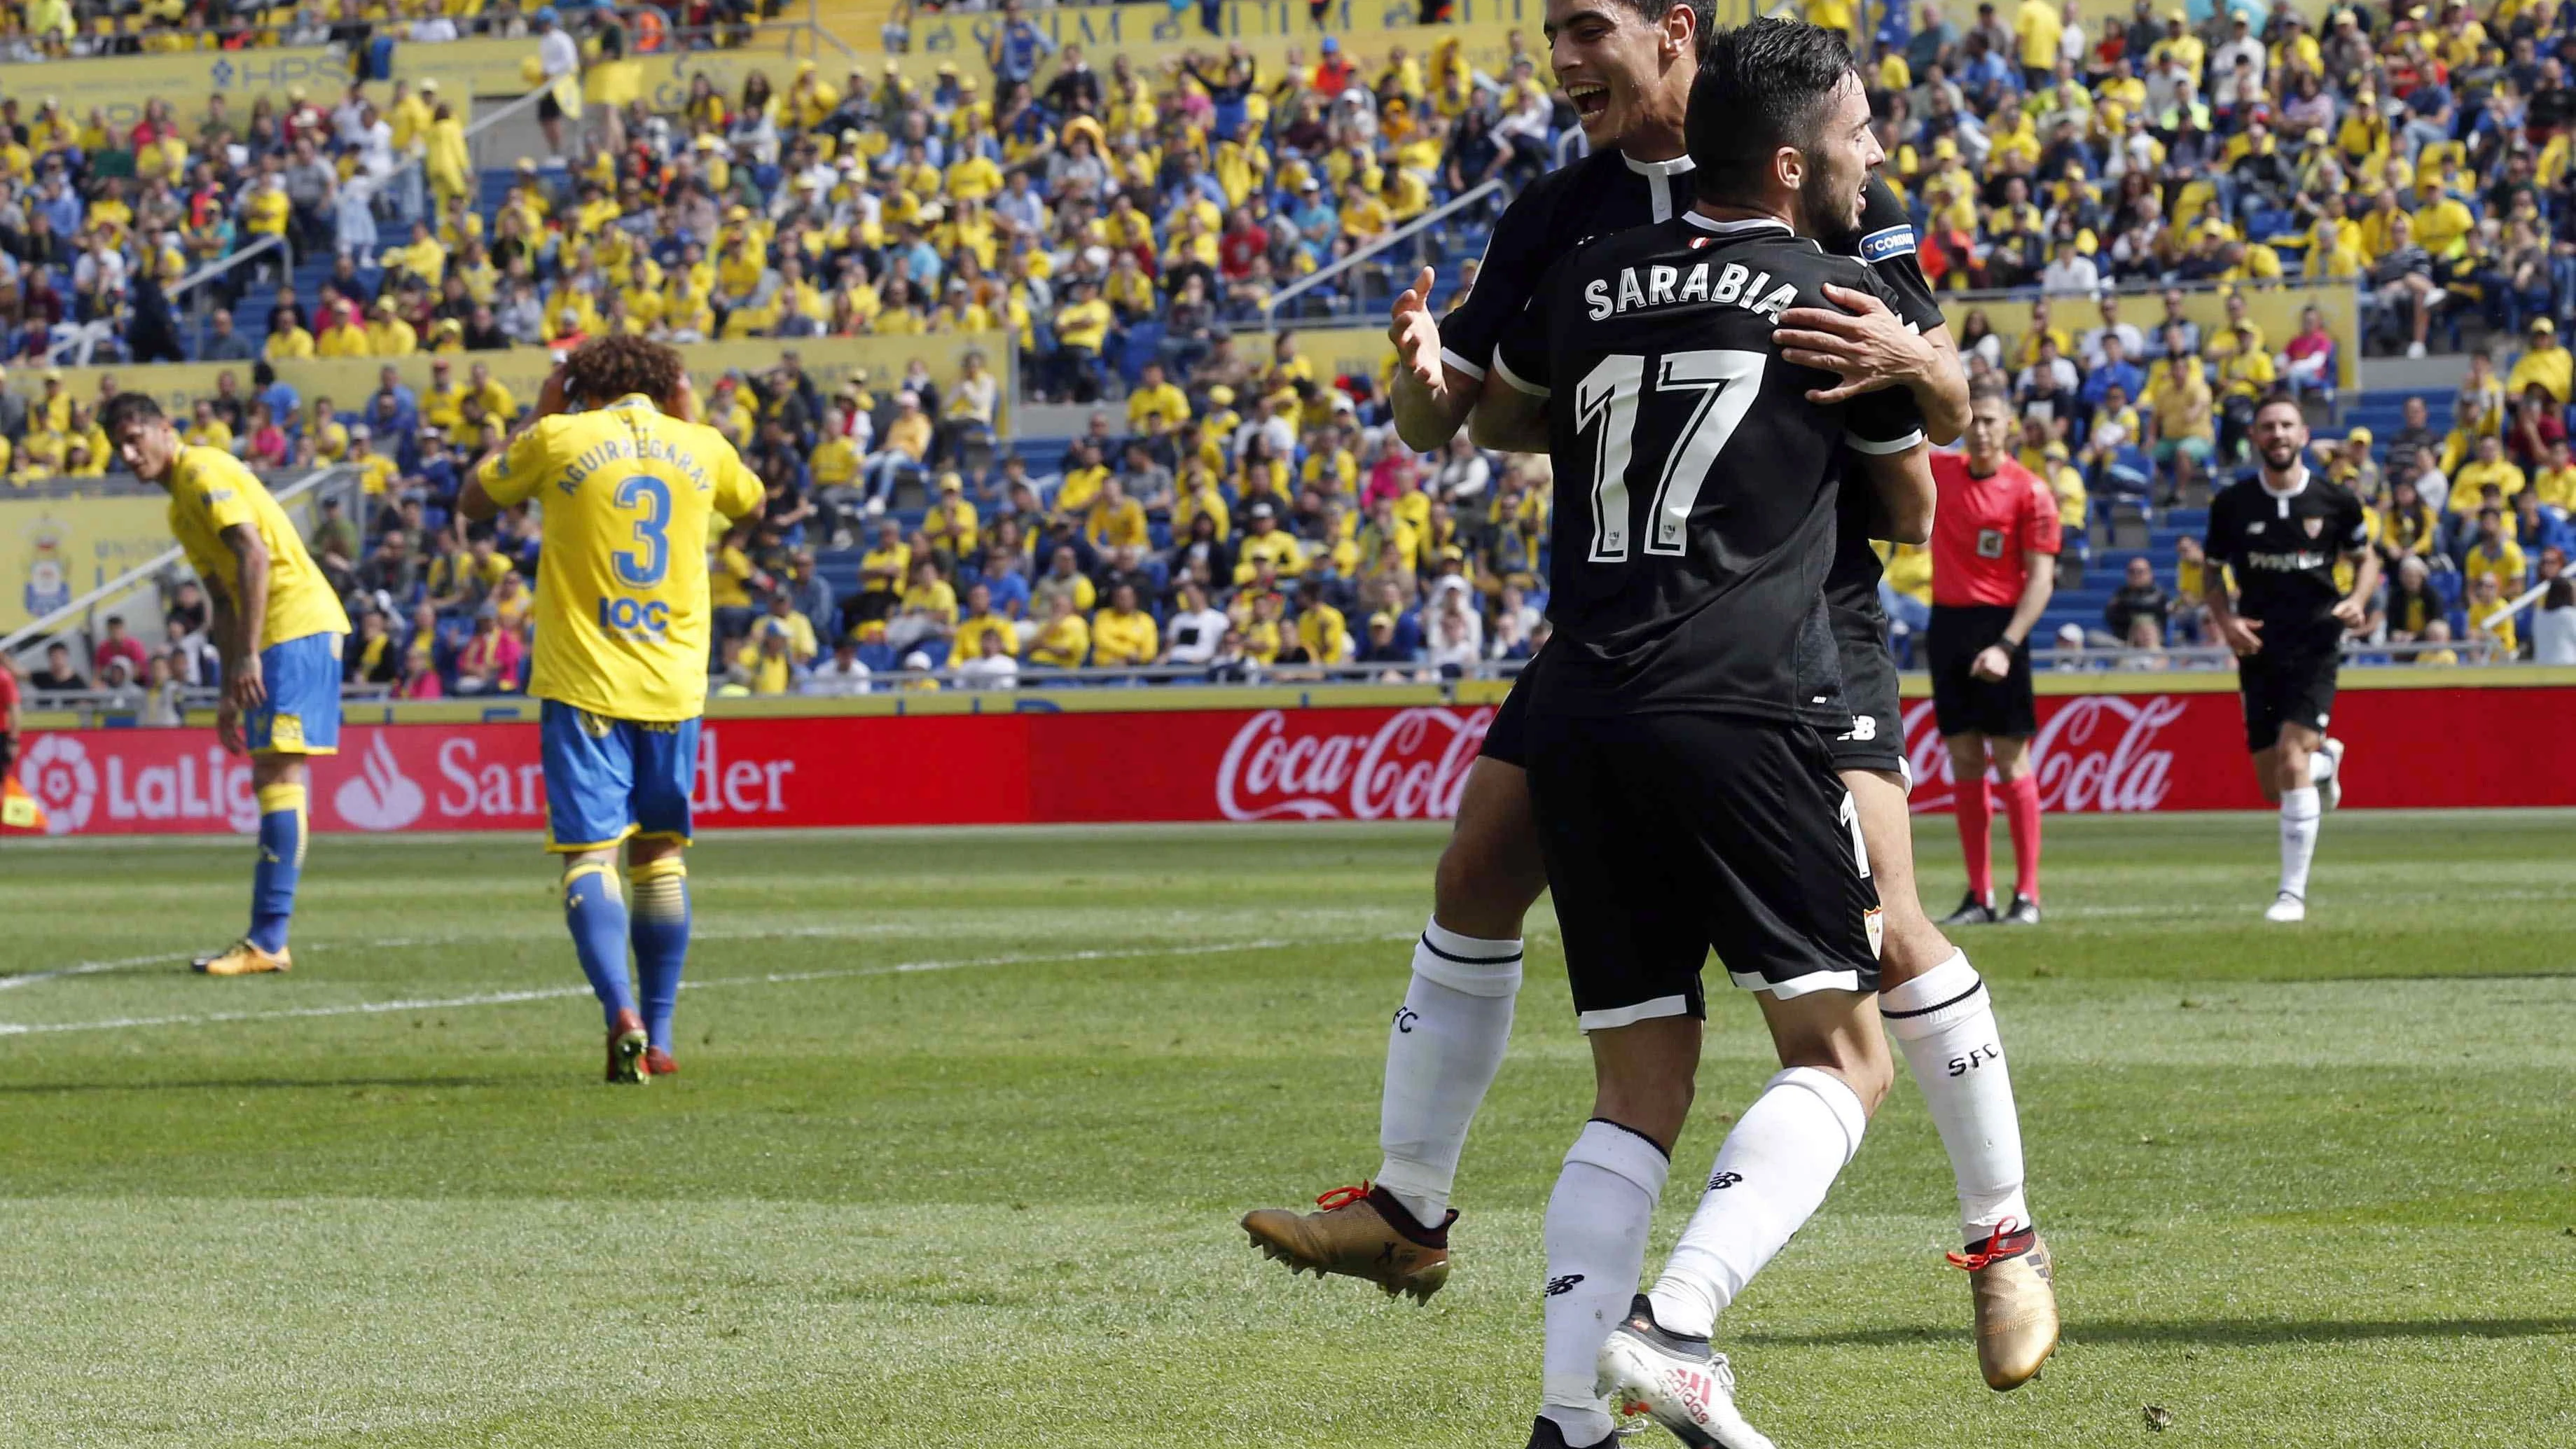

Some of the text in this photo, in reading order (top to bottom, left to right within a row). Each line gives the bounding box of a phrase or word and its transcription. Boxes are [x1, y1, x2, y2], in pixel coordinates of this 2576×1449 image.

[1584, 263, 1799, 325] SARABIA
[558, 438, 711, 496] AGUIRREGARAY
[1575, 349, 1768, 562] 17
[611, 474, 672, 590] 3
[598, 597, 670, 631] IOC
[1948, 1043, 1999, 1077] SFC
[1663, 1368, 1710, 1425] adidas
